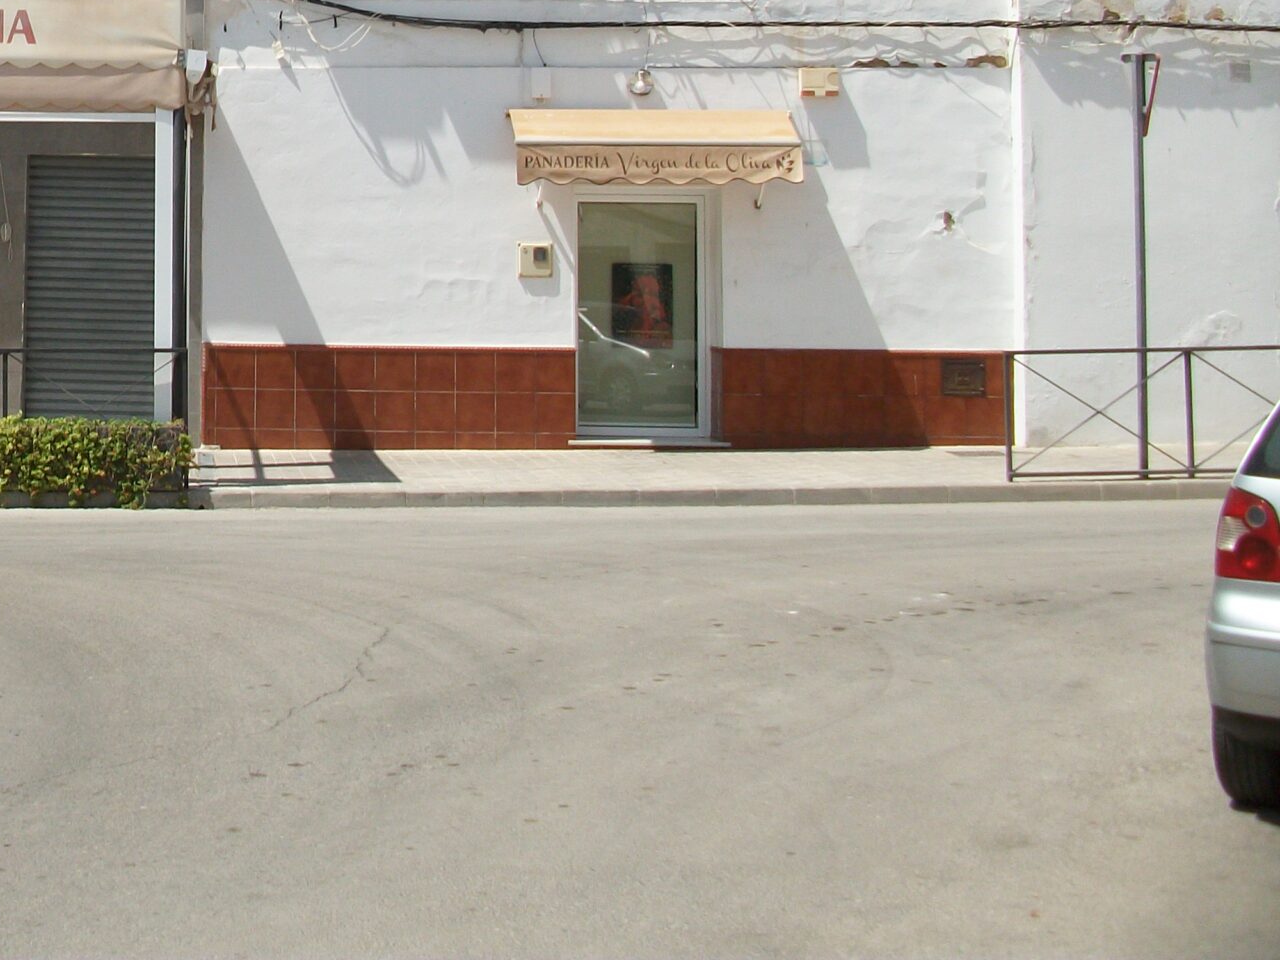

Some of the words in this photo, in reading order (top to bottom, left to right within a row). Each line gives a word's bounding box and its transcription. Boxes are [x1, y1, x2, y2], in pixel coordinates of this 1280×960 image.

[524, 152, 610, 169] PANADERÍA
[616, 151, 679, 175] Virgen
[685, 152, 701, 169] de
[704, 152, 720, 169] la
[726, 152, 772, 173] Oliva
